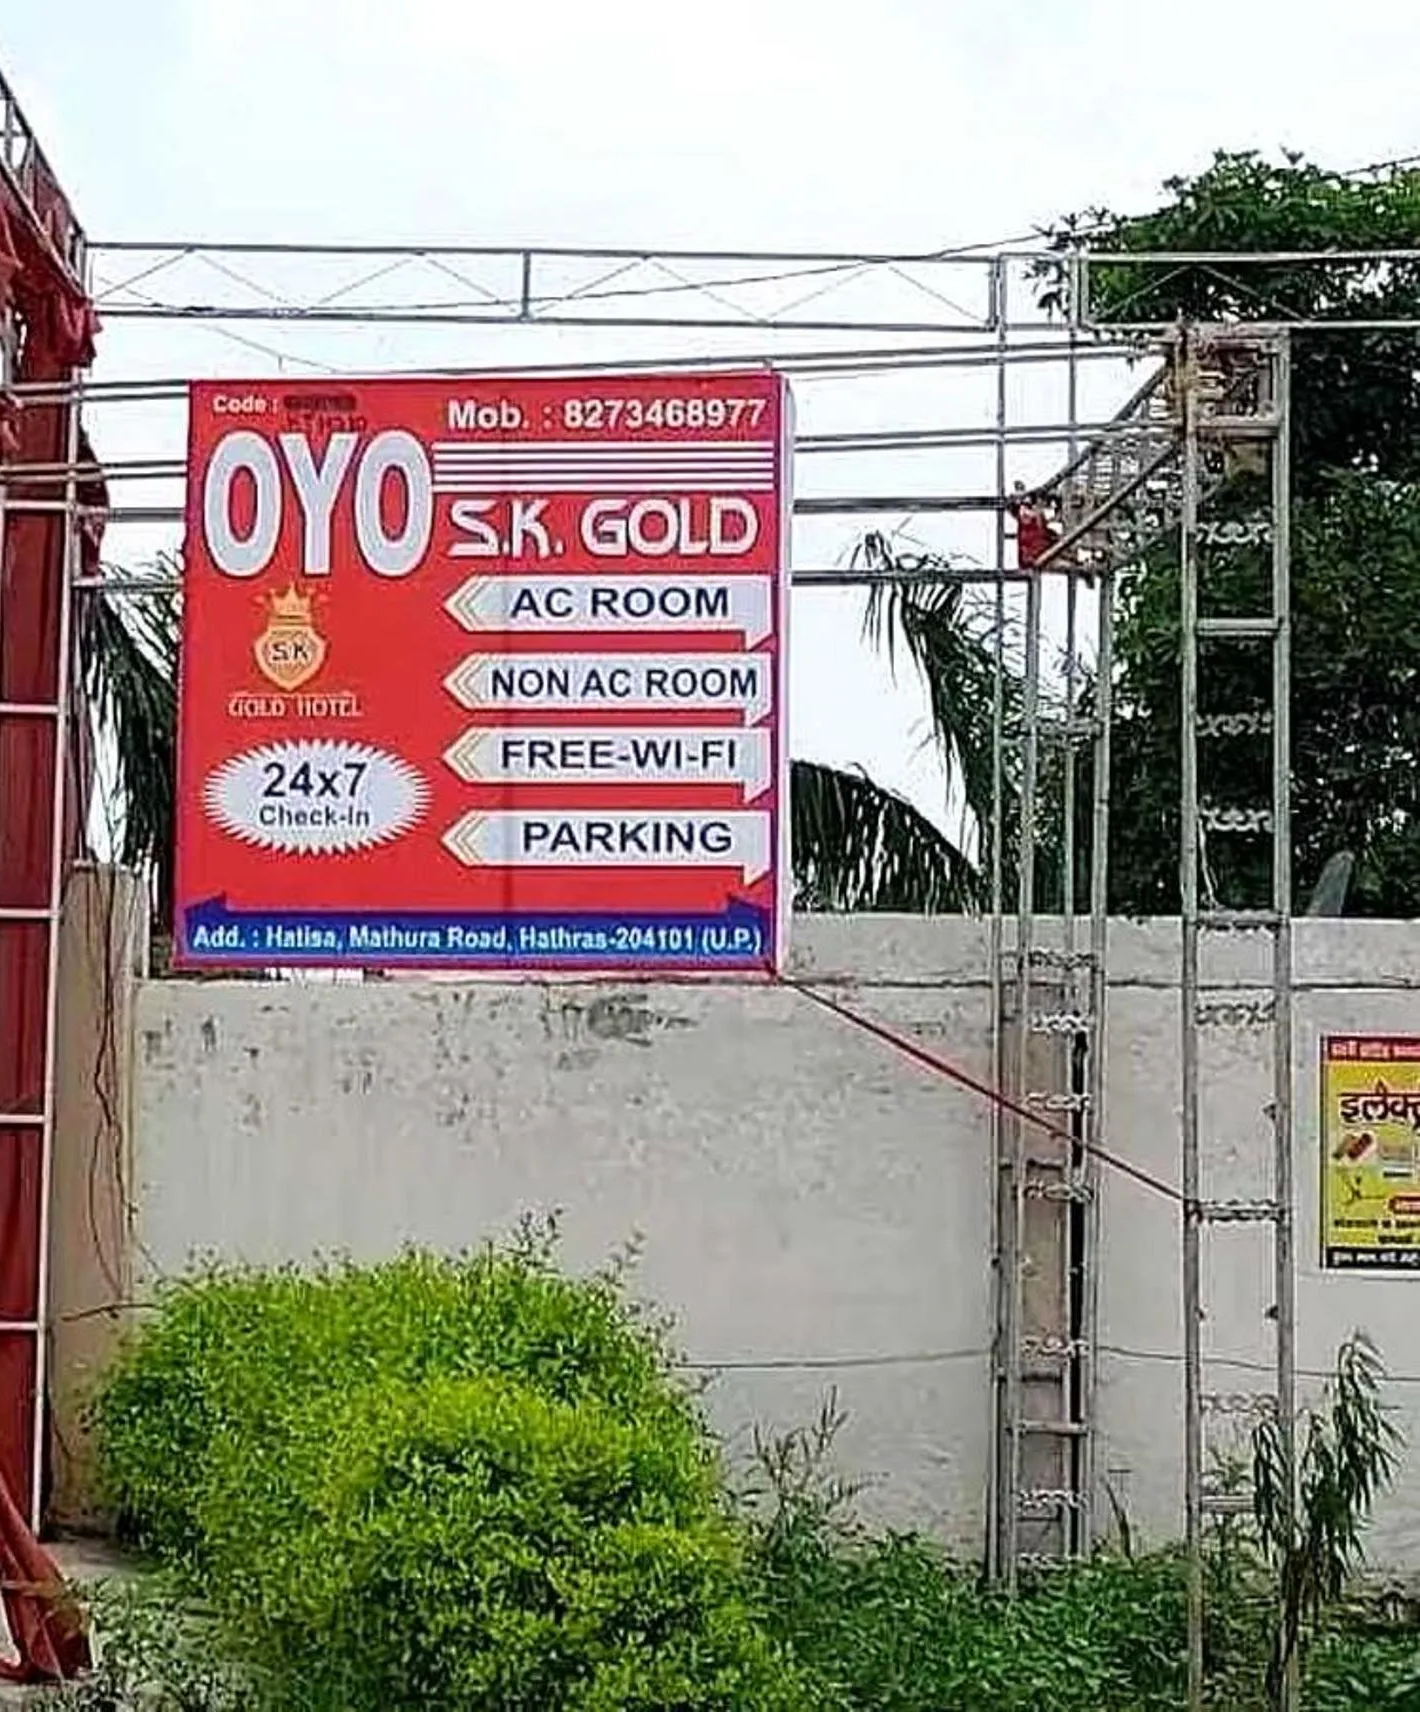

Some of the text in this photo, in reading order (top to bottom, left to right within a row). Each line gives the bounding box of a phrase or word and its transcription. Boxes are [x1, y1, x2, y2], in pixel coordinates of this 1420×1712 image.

[213, 395, 267, 413] Code
[448, 400, 529, 429] Mob.
[563, 398, 766, 428] 8273468977
[205, 431, 433, 577] OYO
[448, 499, 758, 558] S.K. GOLD
[510, 587, 728, 618] AC ROOM
[491, 669, 757, 697] NON AC ROOM
[229, 695, 363, 717] GOLD HOTEL
[501, 740, 735, 769] FREE-WI-FI
[263, 761, 367, 798] 24x7
[260, 805, 370, 826] Check-In
[523, 822, 731, 853] PARKING
[193, 925, 246, 948] Add.
[266, 926, 343, 951] Hatisa,
[349, 926, 440, 948] Mathura
[447, 925, 512, 951] Road,
[520, 926, 693, 950] Hathras-204101
[701, 926, 762, 953] (U.P.)
